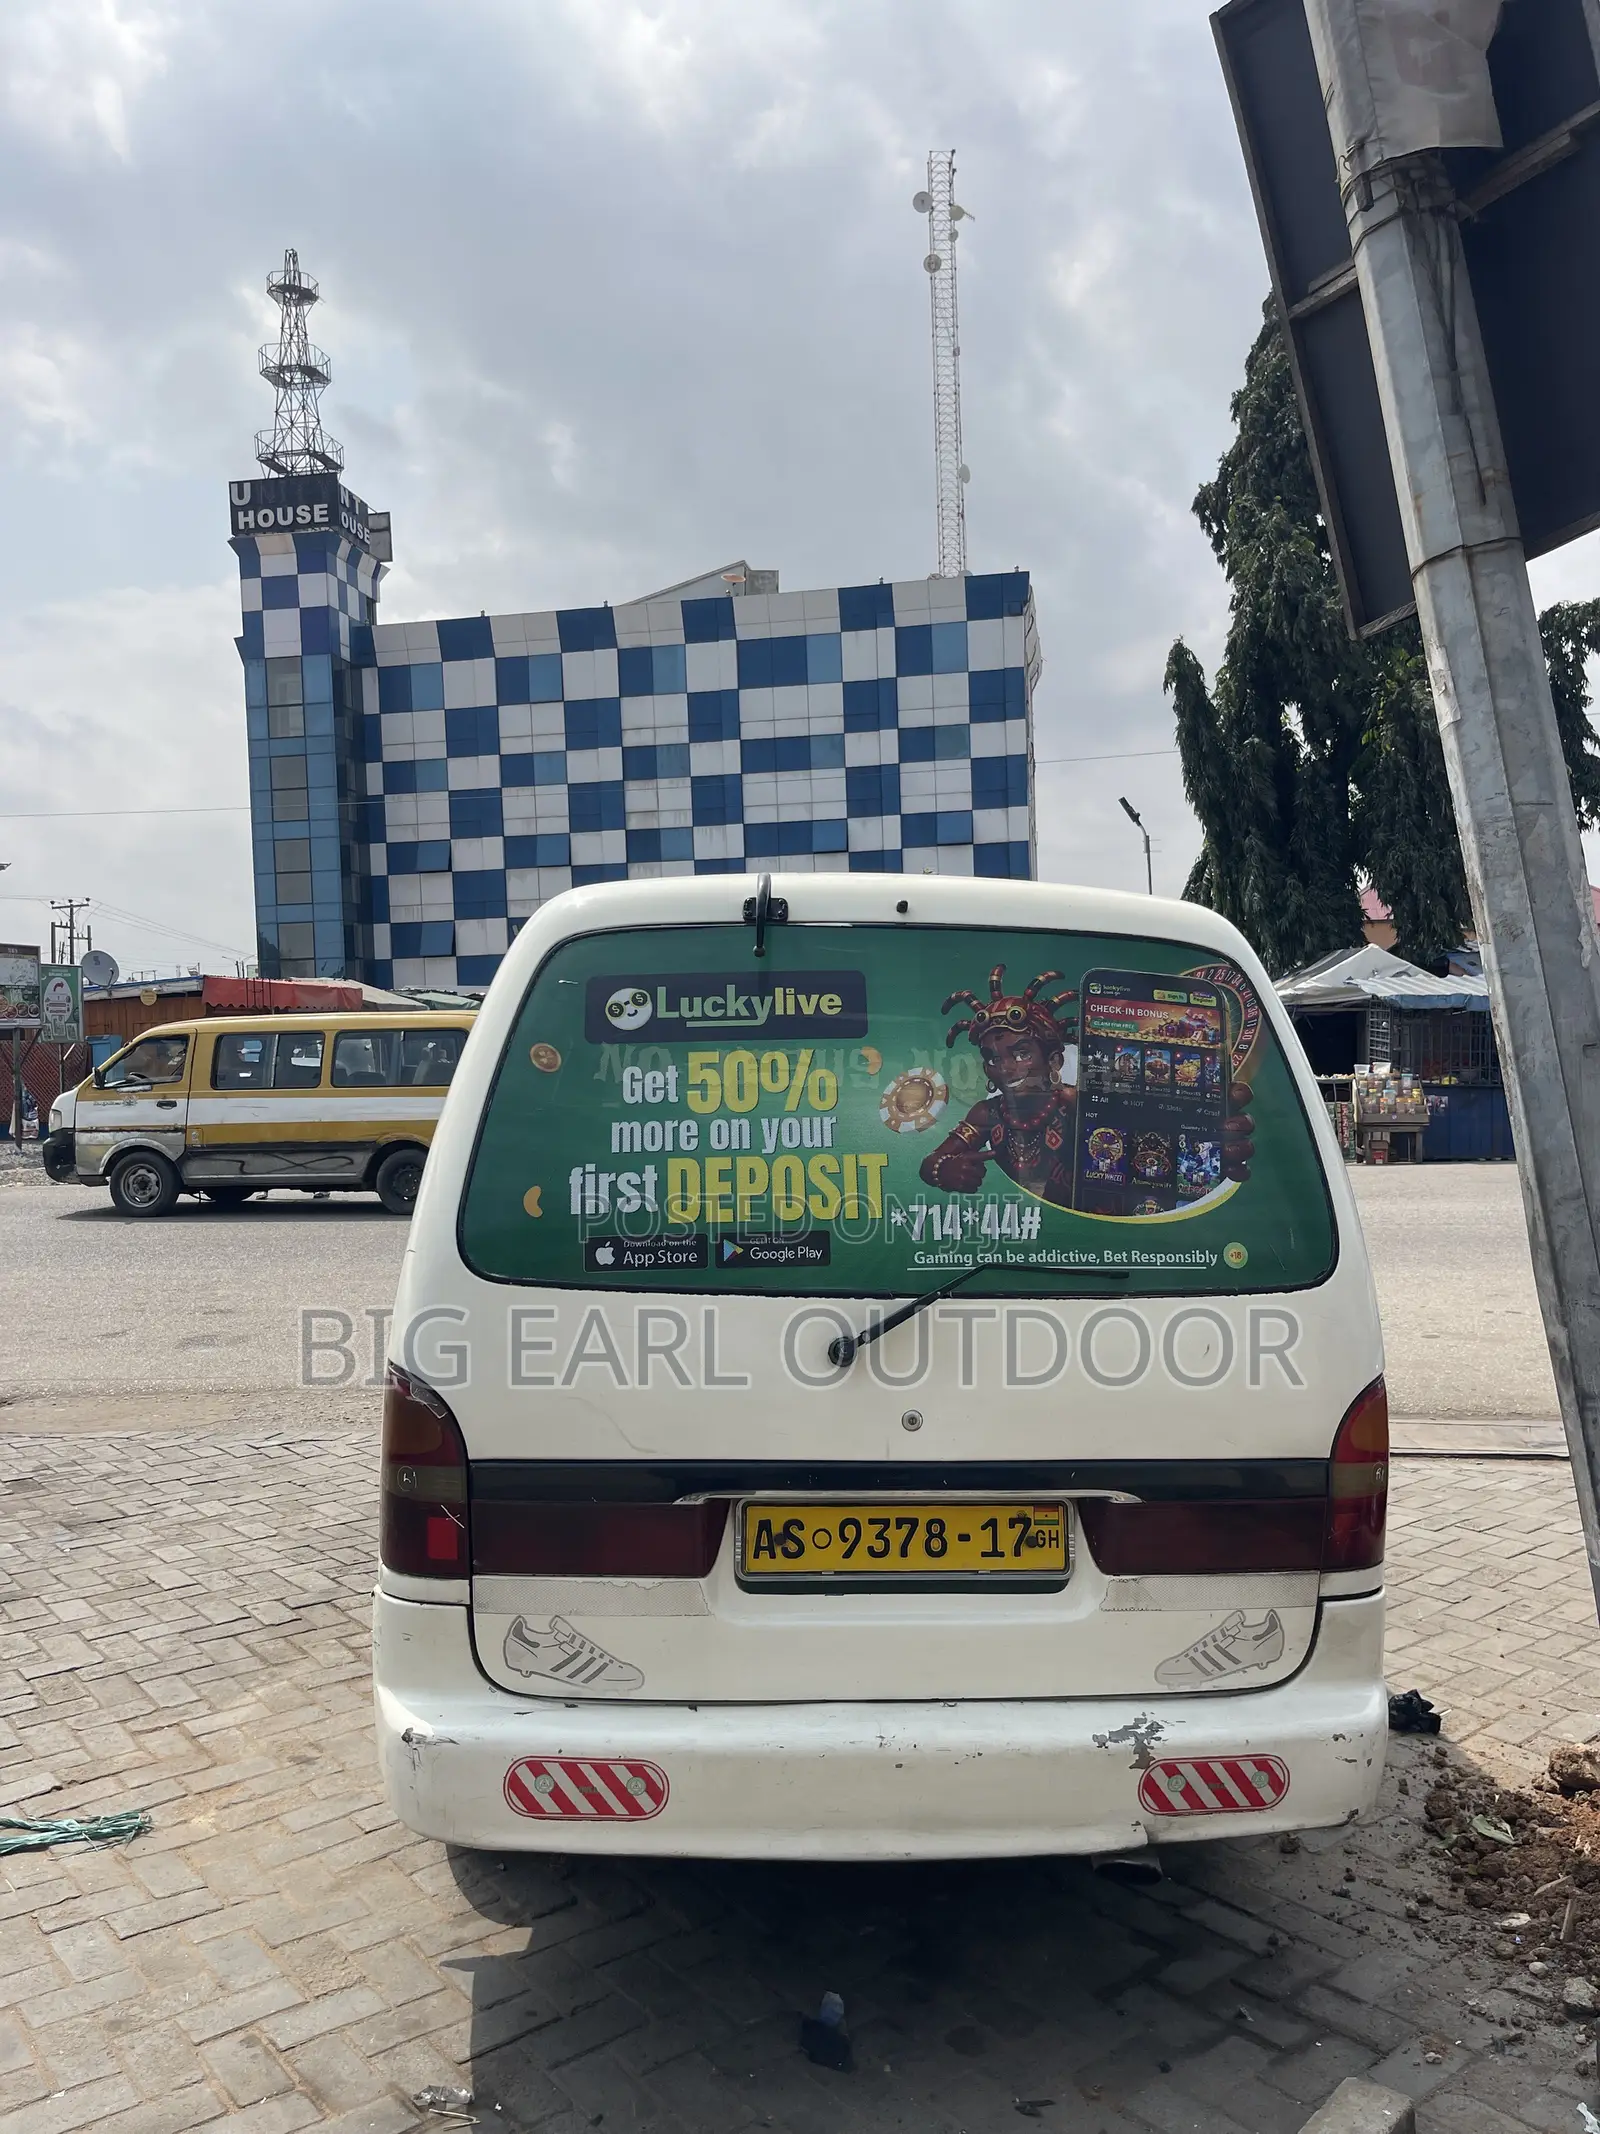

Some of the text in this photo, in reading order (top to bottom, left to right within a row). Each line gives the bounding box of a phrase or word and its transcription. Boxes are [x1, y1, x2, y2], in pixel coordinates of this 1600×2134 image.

[230, 482, 251, 506] U
[237, 503, 329, 530] HOUSE
[341, 511, 371, 545] OUSE
[656, 984, 842, 1027] Luckylive
[1090, 1004, 1169, 1020] CHECK-IN BONUS
[622, 1065, 679, 1104] Get
[687, 1048, 839, 1113] 50%
[611, 1115, 838, 1154] more on your
[569, 1153, 889, 1224] first DEPOSIT
[623, 1249, 699, 1267] App Store
[750, 1245, 823, 1262] Google Play
[914, 1249, 1219, 1267] Gaming can be addictive, Bet Responsibly
[753, 1518, 805, 1560] AS
[1036, 1529, 1059, 1548] GH
